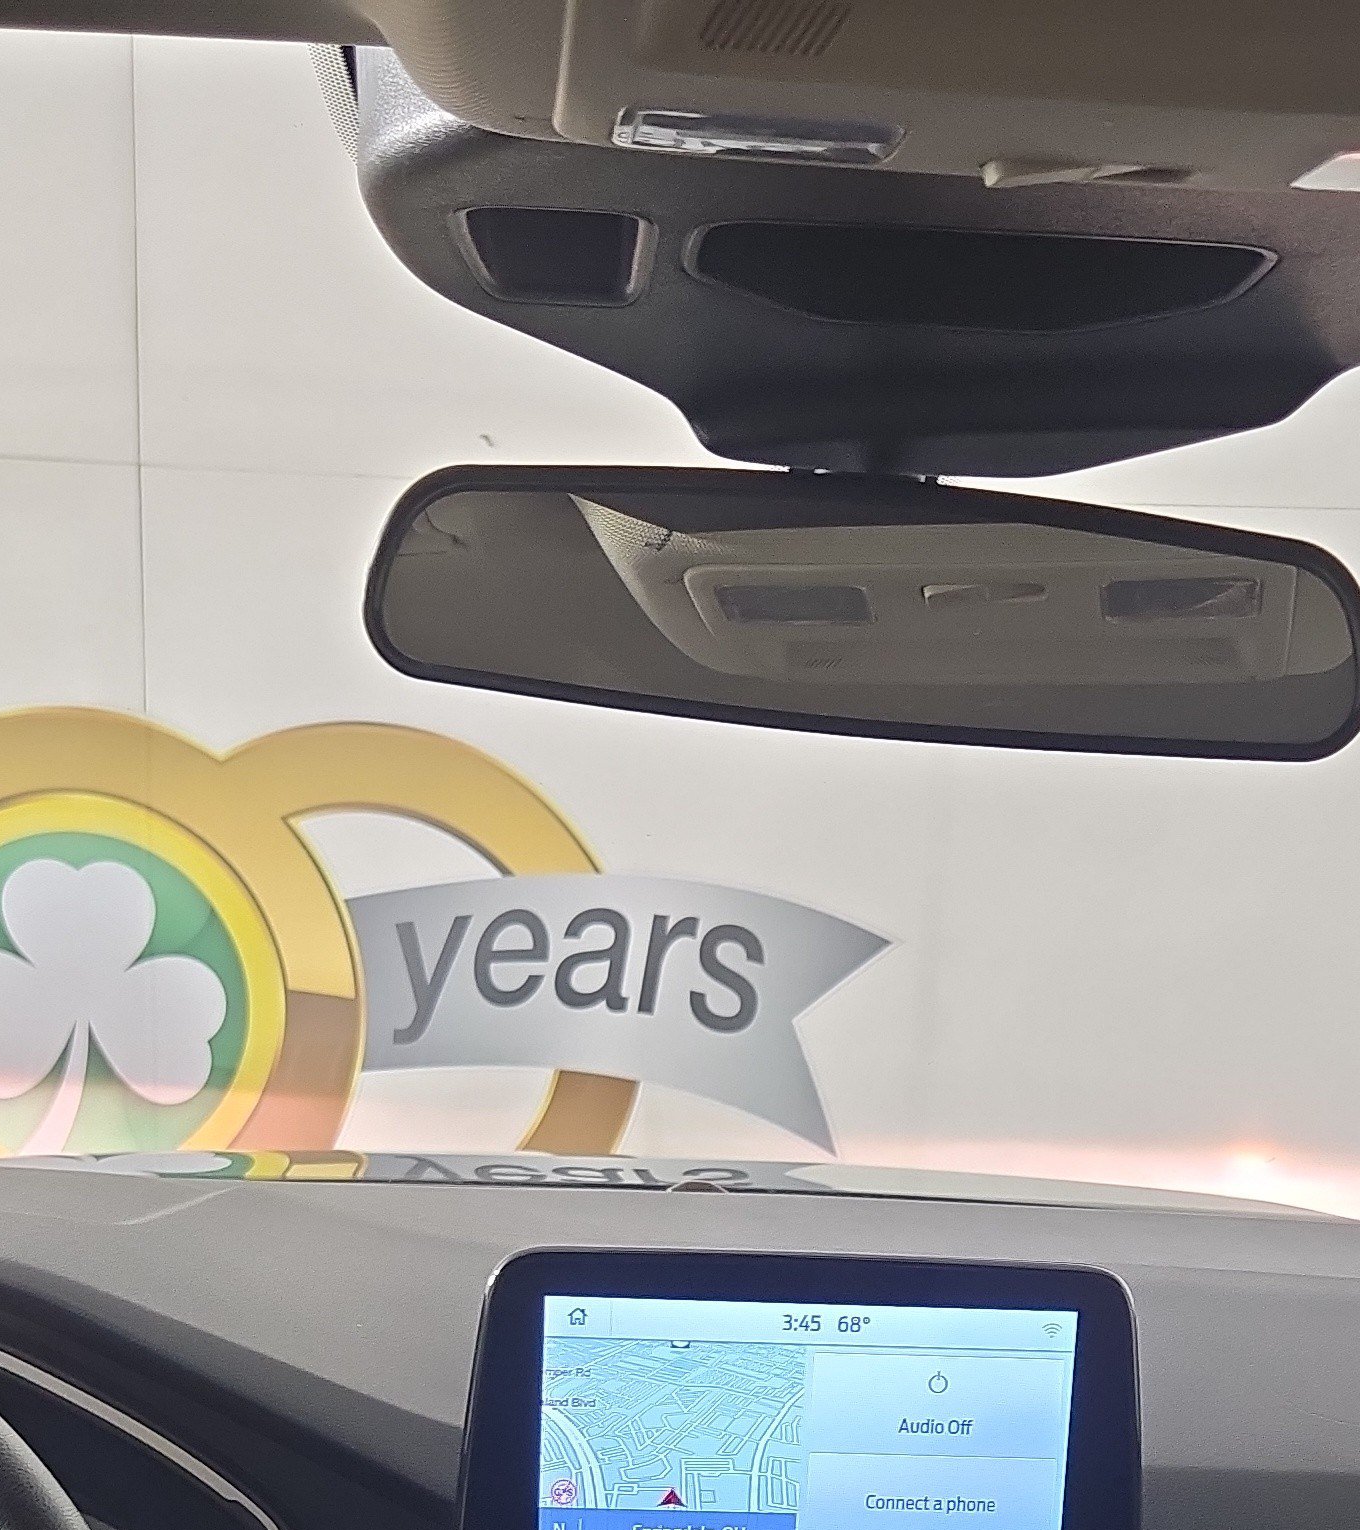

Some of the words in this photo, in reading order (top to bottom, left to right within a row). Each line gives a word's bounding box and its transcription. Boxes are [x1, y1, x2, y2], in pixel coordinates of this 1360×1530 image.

[392, 905, 766, 1045] years
[781, 1313, 822, 1333] 3:45
[836, 1315, 871, 1334] 68°
[897, 1418, 945, 1435] Audio
[947, 1419, 975, 1436] Off
[865, 1493, 930, 1512] Connect
[932, 1498, 943, 1512] a
[946, 1495, 997, 1515] phone
